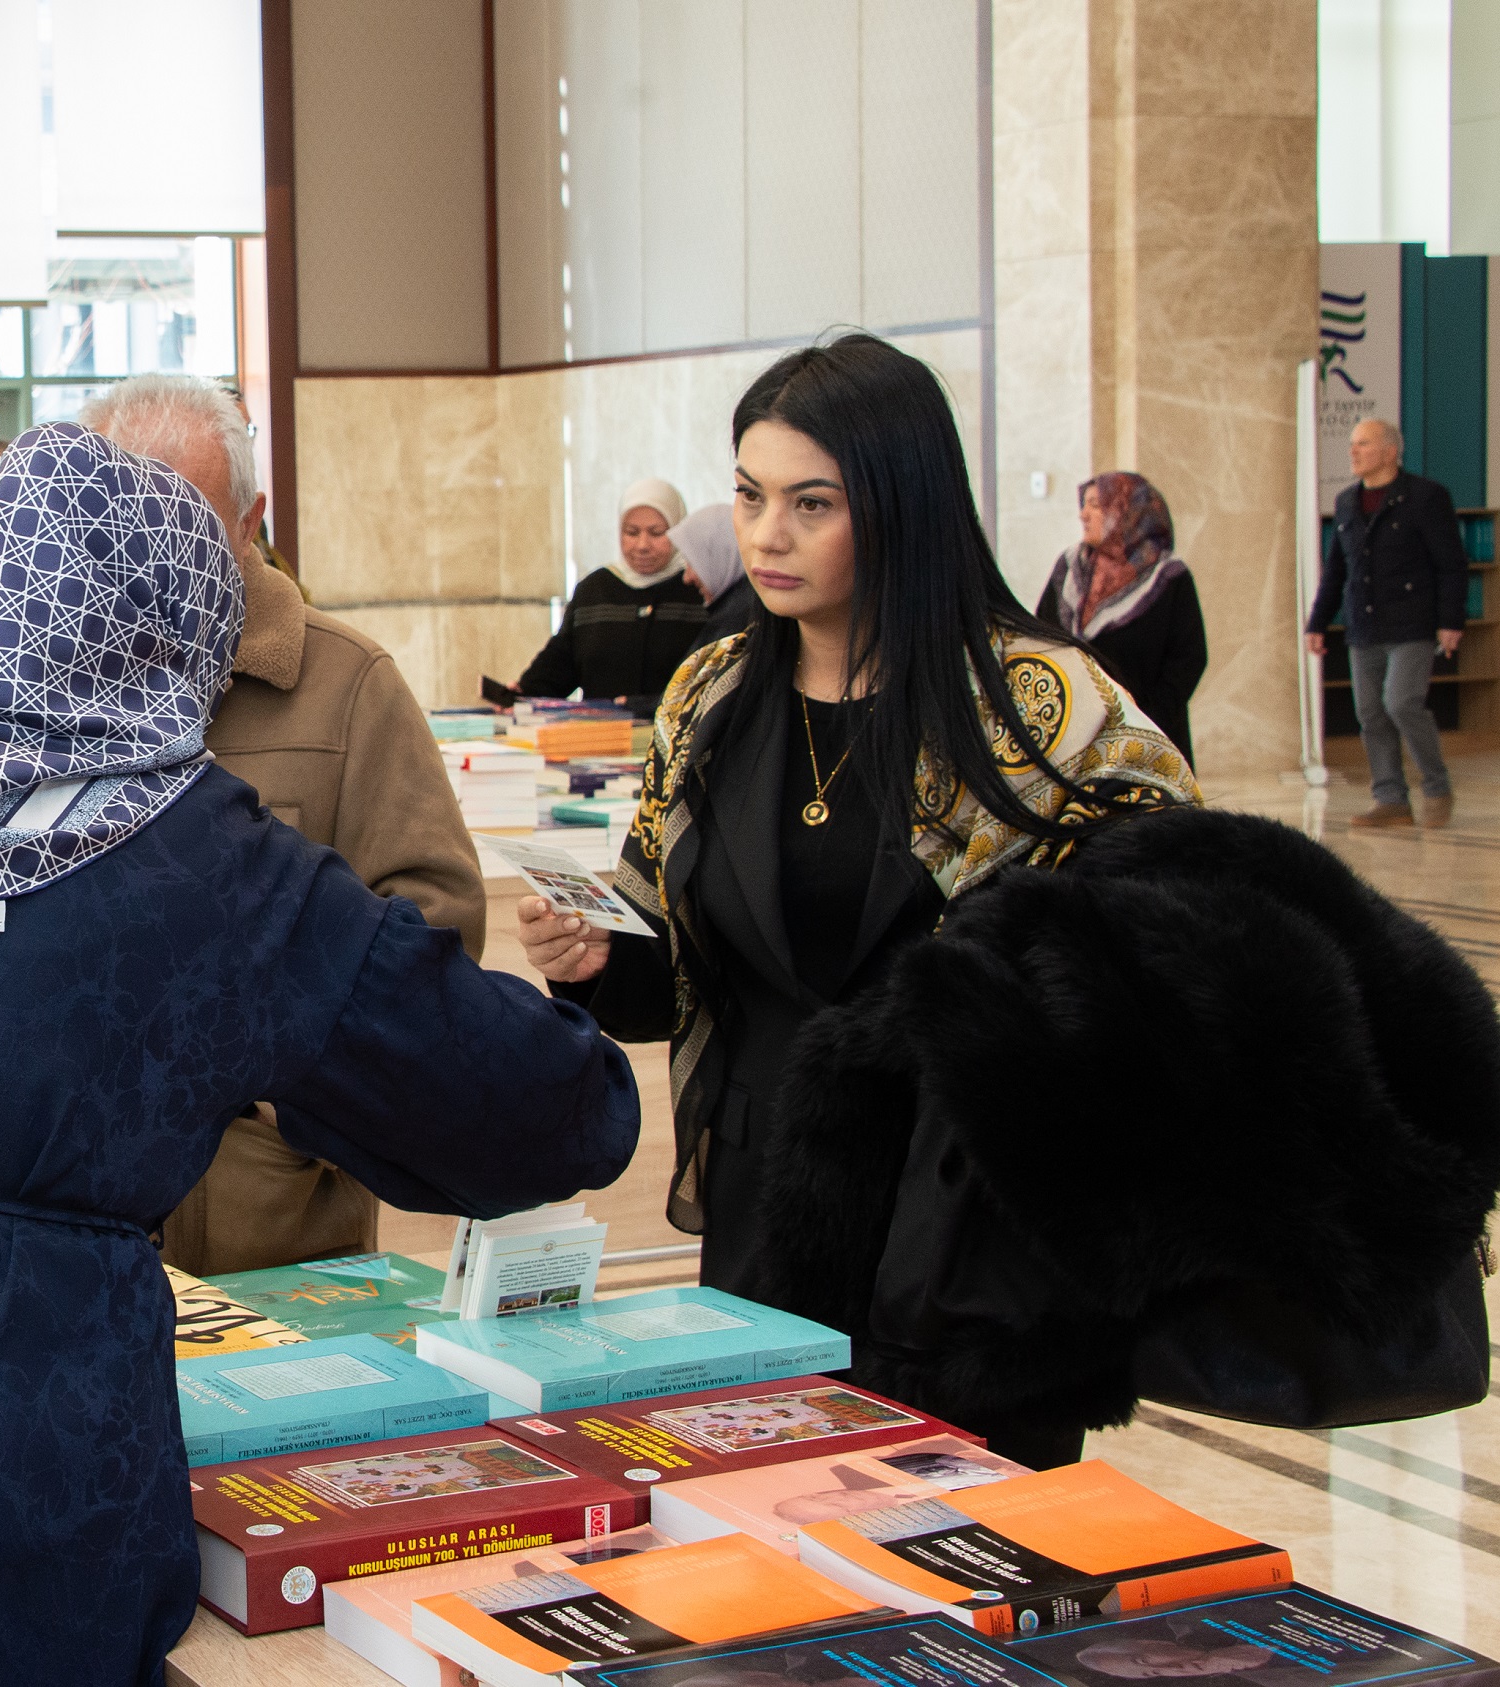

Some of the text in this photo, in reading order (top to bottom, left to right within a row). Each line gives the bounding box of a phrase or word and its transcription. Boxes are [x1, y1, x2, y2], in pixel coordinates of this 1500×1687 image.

[672, 1380, 697, 1389] KONYA
[295, 1439, 320, 1448] KONYA
[322, 1434, 361, 1444] NUMARALI
[578, 1429, 643, 1460] ULUSLAR ARASI
[238, 1448, 262, 1457] SİCİLİ
[215, 1486, 272, 1516] ULUSLAR ARASI
[592, 1508, 605, 1536] 700
[388, 1523, 516, 1554] ULUSLAR ARASI
[947, 1536, 980, 1552] KİTABI
[348, 1533, 553, 1577] KURULUŞUNUN 700. YIL DÖNÜMÜNDE
[932, 1539, 985, 1565] TERCÜMELİ
[975, 1551, 1003, 1564] FIKIH
[981, 1563, 1031, 1583] SATIRALTI
[999, 1562, 1020, 1571] BİR
[545, 1609, 594, 1635] TERCÜMELİ
[561, 1606, 593, 1622] KİTABI
[587, 1621, 614, 1634] FIKIH
[590, 1634, 635, 1654] SATIRALTI
[608, 1632, 629, 1641] BİR
